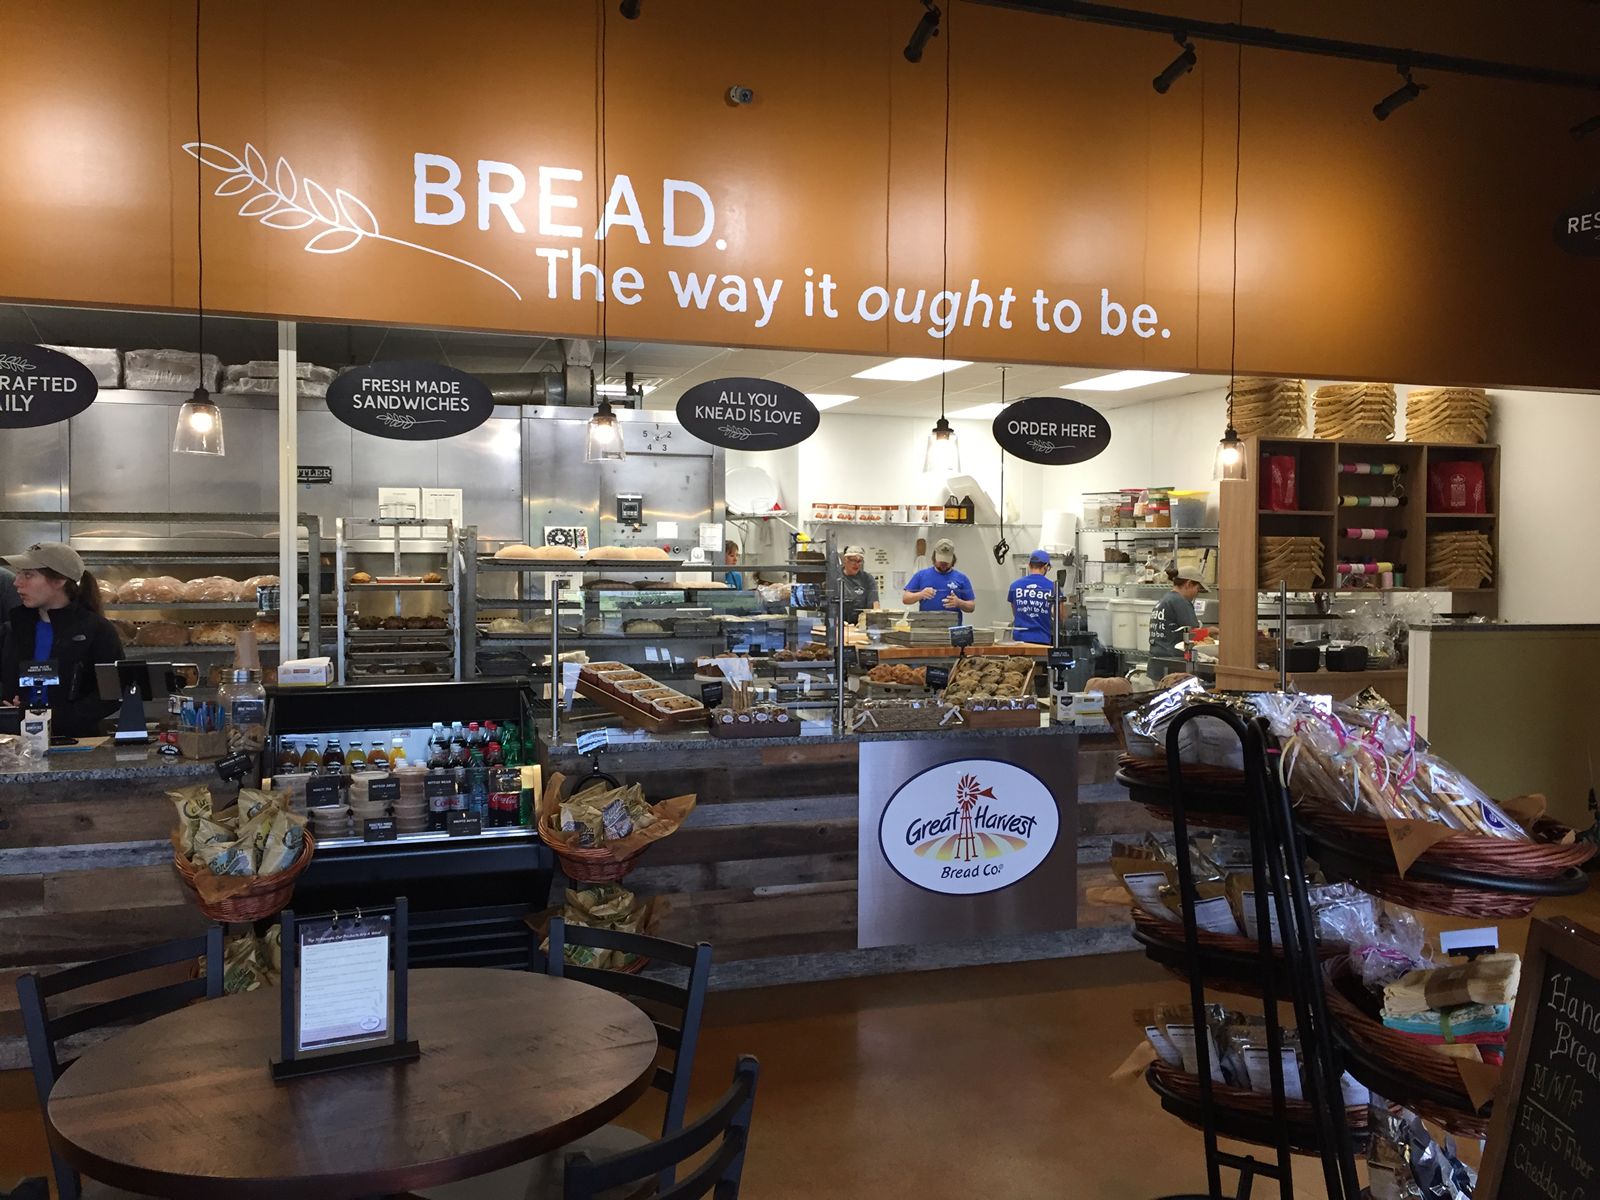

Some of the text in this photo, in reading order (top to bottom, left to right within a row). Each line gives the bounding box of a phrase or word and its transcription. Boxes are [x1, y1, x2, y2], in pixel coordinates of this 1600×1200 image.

[413, 152, 728, 250] BREAD.
[536, 248, 1171, 338] The way it ought to be.
[362, 378, 460, 394] FRESH MADE
[0, 394, 34, 412] ILY
[353, 394, 470, 412] SANDWICHES
[719, 391, 777, 407] ALL YOU
[695, 406, 802, 424] KNEAD IS LOVE
[1007, 420, 1096, 438] ORDER HERE
[905, 805, 1037, 846] Great Harvest
[940, 864, 980, 879] Bread
[1521, 1104, 1547, 1146] High
[1551, 1128, 1563, 1151] 5
